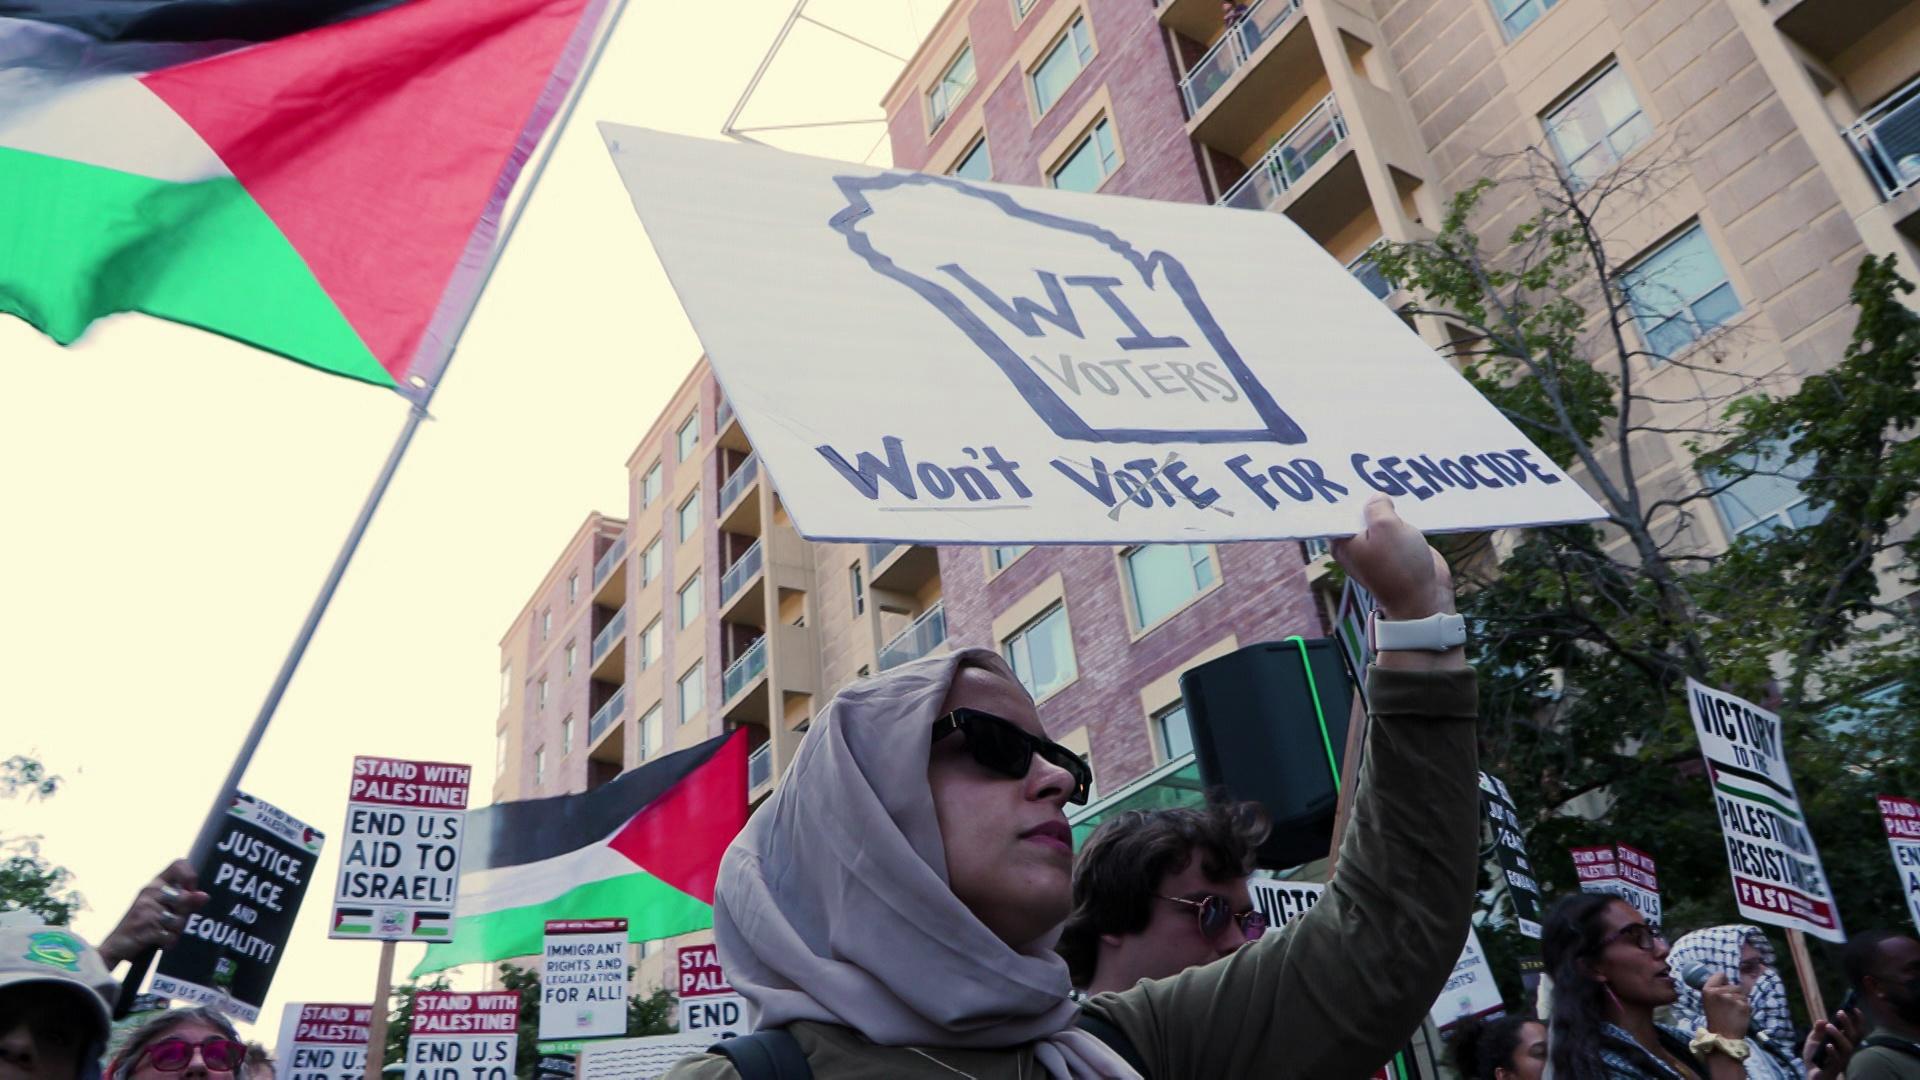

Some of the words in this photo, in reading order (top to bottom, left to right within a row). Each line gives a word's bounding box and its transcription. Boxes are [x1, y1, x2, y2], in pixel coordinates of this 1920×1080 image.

[936, 263, 1191, 350] WI
[1030, 354, 1238, 402] VOTERS
[816, 435, 1033, 500] Won't
[1050, 456, 1222, 510] VOTE
[1225, 453, 1349, 511] FOR
[1351, 448, 1562, 501] GENOCIDE
[1693, 688, 1779, 762] VICTORY
[1732, 744, 1751, 768] TO
[354, 759, 418, 780] STAND
[423, 765, 470, 784] WITH
[351, 779, 468, 806] PALESTINE!
[350, 811, 406, 836] END
[345, 839, 402, 868] AID
[416, 844, 456, 872] TO
[341, 871, 454, 902] ISRAEL!
[1740, 883, 1790, 912] FRSO
[184, 913, 275, 964] EQUALITY!
[547, 942, 622, 957] IMMIGRANT
[546, 960, 591, 972] RIGHTS
[596, 957, 622, 970] AND
[680, 950, 721, 970] STA
[546, 973, 622, 985] LEGALIZATION
[415, 994, 472, 1012] STAND
[476, 995, 518, 1011] WITH
[545, 987, 579, 1004] FOR
[586, 986, 622, 1002] ALL!
[302, 1006, 350, 1022] STAND
[688, 1001, 739, 1029] END
[298, 1023, 370, 1040] PALESTIN
[293, 1049, 335, 1069] END
[415, 1042, 462, 1064] END
[471, 1041, 509, 1062] U.S
